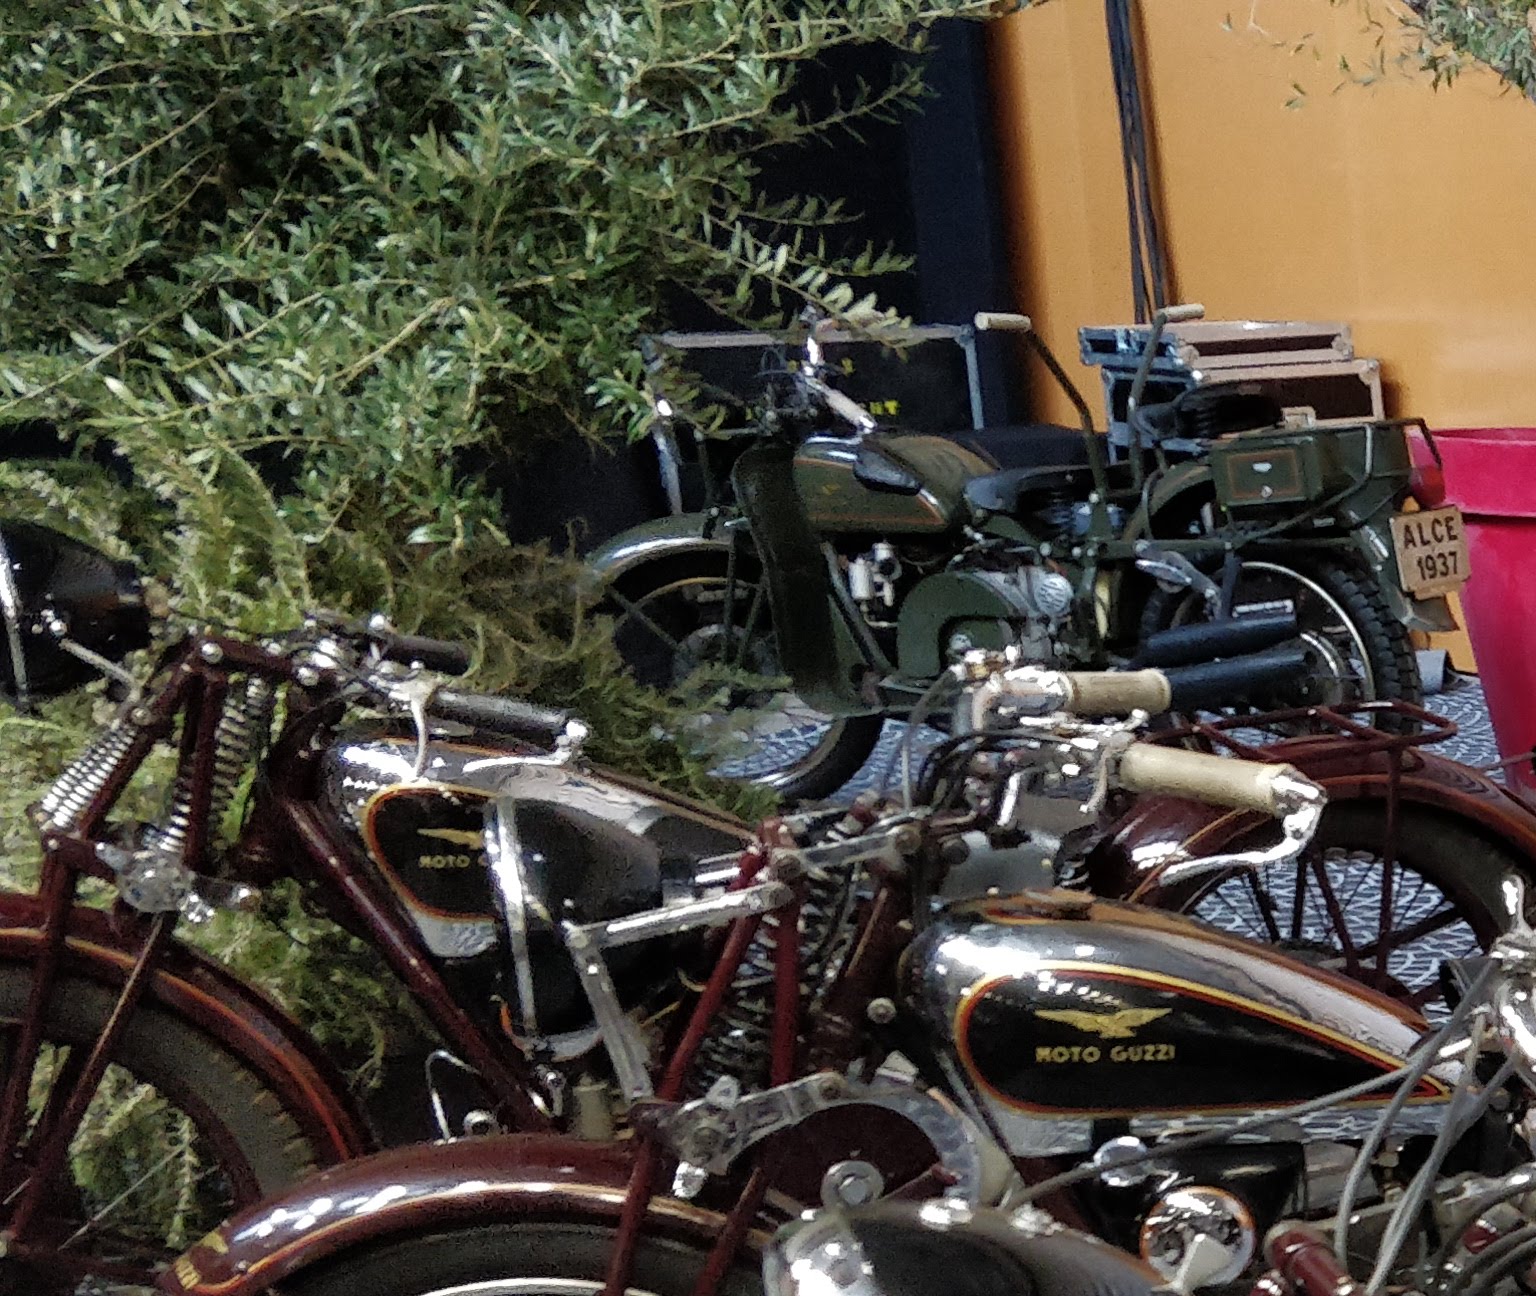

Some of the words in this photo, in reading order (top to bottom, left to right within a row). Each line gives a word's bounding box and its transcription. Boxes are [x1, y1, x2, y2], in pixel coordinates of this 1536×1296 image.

[1404, 516, 1458, 549] ALCE
[1417, 551, 1457, 580] 1937
[419, 855, 470, 868] MOTO
[1035, 1046, 1101, 1063] MOTO
[1110, 1044, 1176, 1062] GUZZI
